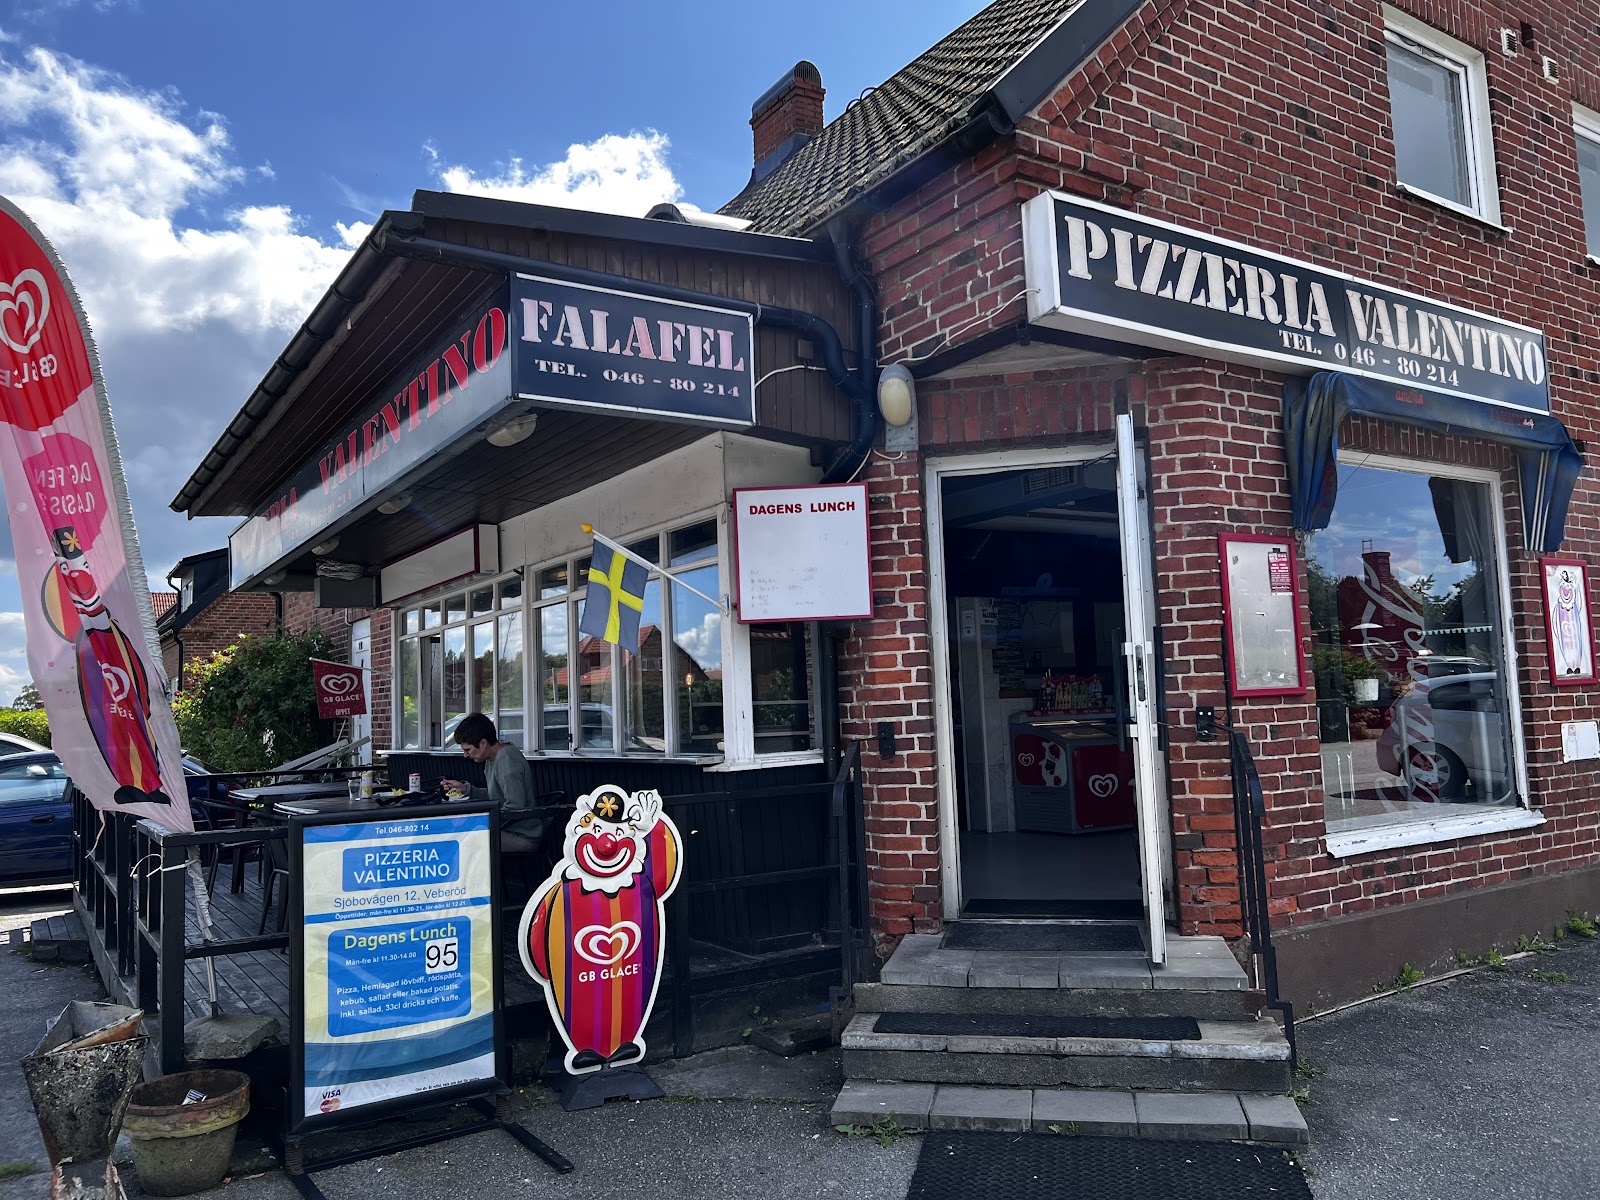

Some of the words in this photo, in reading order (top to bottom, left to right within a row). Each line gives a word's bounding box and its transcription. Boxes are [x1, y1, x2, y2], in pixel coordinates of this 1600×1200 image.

[1064, 215, 1336, 337] PIZZERIA
[1345, 289, 1544, 386] VALENTINO
[520, 298, 744, 372] FALAFEL
[1278, 329, 1322, 355] TEL.
[1397, 356, 1421, 378] 80
[1426, 363, 1459, 387] 214
[534, 359, 587, 378] TEL.
[602, 369, 645, 386] 046
[670, 377, 696, 392] 80
[703, 381, 740, 398] 214
[319, 307, 506, 496] VALENTINO
[749, 503, 803, 515] DAGENS
[810, 501, 855, 513] LUNCH
[335, 694, 360, 702] GLACE
[420, 824, 430, 832] 14
[365, 848, 439, 867] PIZZERIA
[354, 863, 450, 884] VALENTINO
[334, 893, 400, 909] Sjöbovägen
[405, 891, 420, 902] 12,
[424, 886, 467, 899] Veberöd
[344, 932, 406, 951] Dagens
[410, 922, 457, 942] Lunch
[345, 958, 372, 967] Mån-fre
[381, 952, 417, 962] 11.30-14.00
[426, 942, 457, 969] 95
[336, 987, 360, 995] Pizza,
[361, 980, 400, 992] Hemlagad
[401, 976, 427, 986] lövbiff,
[428, 972, 463, 982] rödspätta,
[578, 971, 596, 982] GB
[600, 963, 639, 979] GLACE
[368, 992, 391, 1003] sallad
[392, 991, 409, 999] eller
[410, 986, 433, 996] bakad
[434, 983, 460, 993] potatis.
[340, 1010, 357, 1018] inkl.
[358, 1005, 384, 1016] sallad,
[385, 1002, 401, 1012] 33cl
[402, 1000, 425, 1009] dricka
[441, 994, 461, 1002] kaffe.
[322, 1089, 341, 1100] VISA
